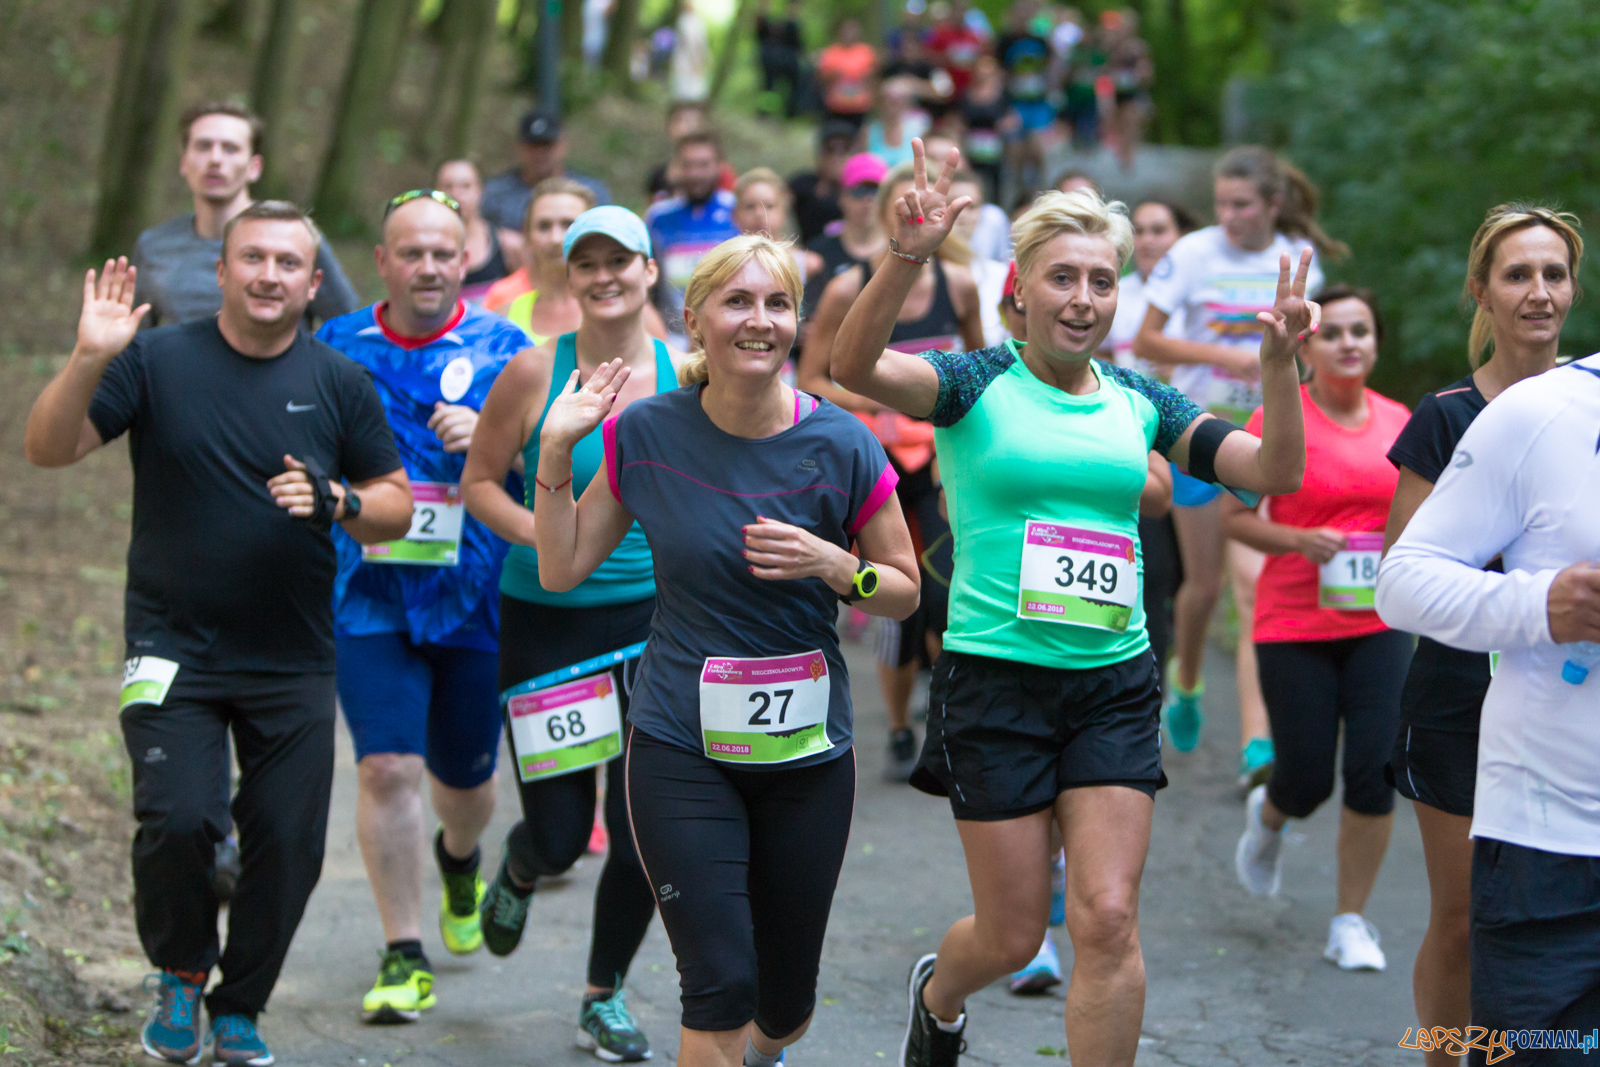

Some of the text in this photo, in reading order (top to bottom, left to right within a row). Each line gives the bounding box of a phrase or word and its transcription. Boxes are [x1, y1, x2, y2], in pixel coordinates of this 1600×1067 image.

[1055, 556, 1118, 594] 349
[1027, 602, 1064, 614] 22.06.2018
[751, 666, 804, 676] BIEGCZEKOLADOWY.PL
[748, 689, 794, 726] 27
[546, 710, 586, 743] 68
[712, 743, 749, 753] 22.06.2018
